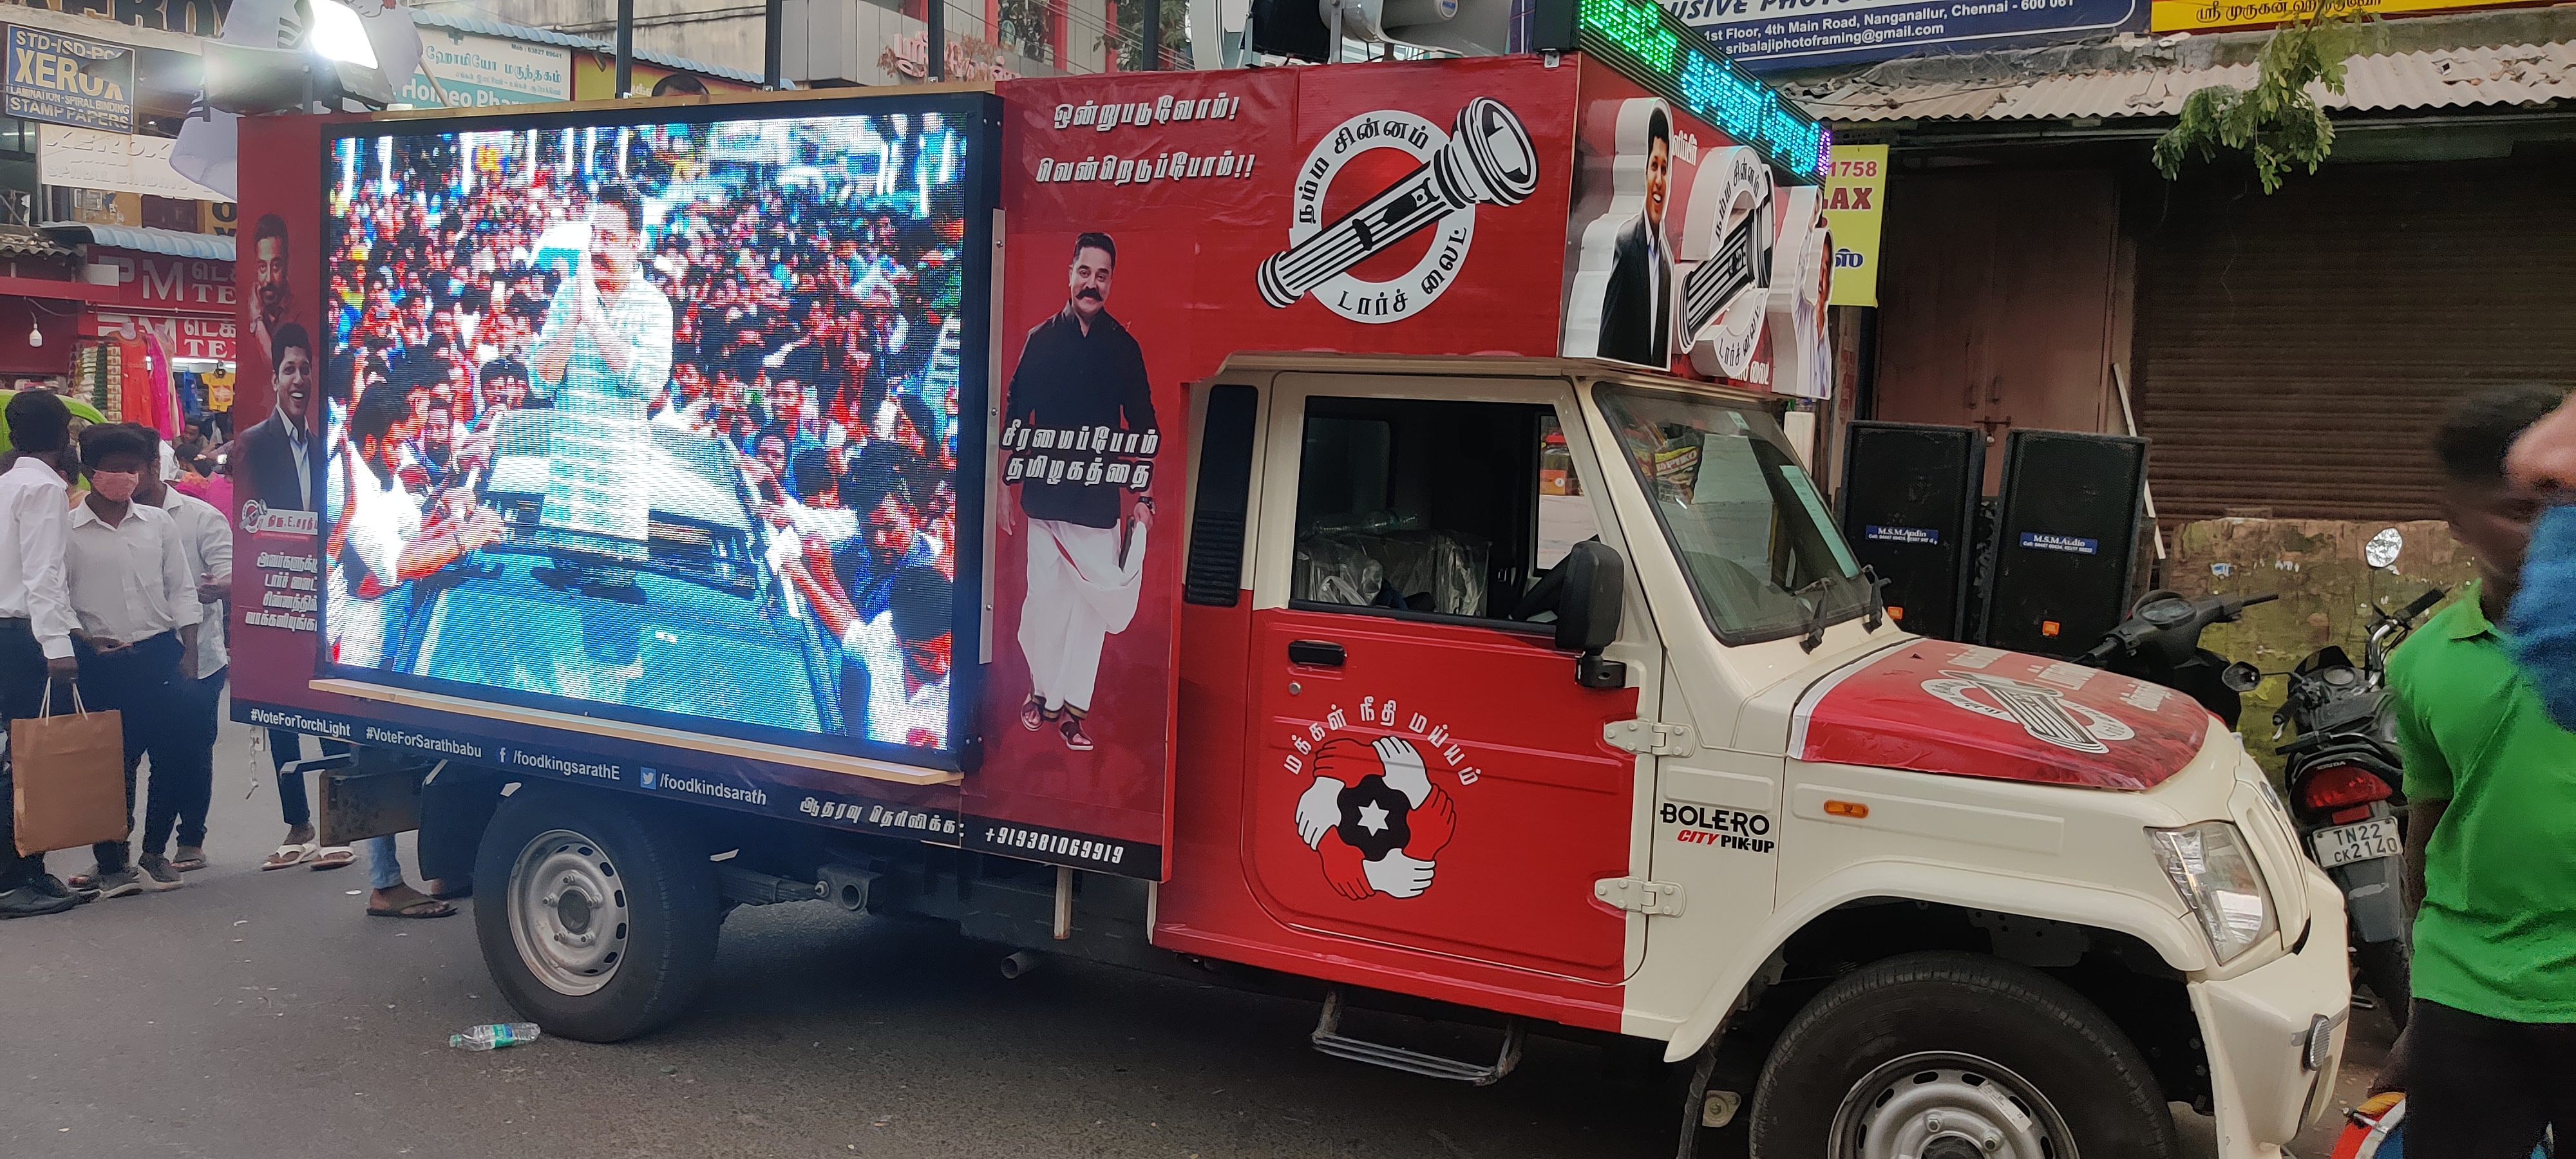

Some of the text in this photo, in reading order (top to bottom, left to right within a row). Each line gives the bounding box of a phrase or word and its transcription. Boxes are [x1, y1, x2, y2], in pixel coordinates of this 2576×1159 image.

[1704, 30, 1723, 41] 1st
[1726, 27, 1761, 40] Floor,
[1764, 24, 1785, 35] 4th
[1788, 20, 1819, 33] Main
[1823, 15, 1860, 30] Road,
[1864, 7, 1947, 26] Nanganallur,
[1951, 0, 2008, 17] Chennai
[1725, 24, 1944, 55] sribalajiphotoframing@gmail.com
[1054, 91, 1240, 132] ஒன்றுபடுவோம்!
[1334, 117, 1430, 155] சின்னம்
[1337, 288, 1409, 316] டார்ச்
[1001, 419, 1159, 455] சீரமைப்போம்
[1005, 455, 1150, 489] தமிழகத்தை
[250, 708, 351, 738] #VoteForTorchLight
[365, 726, 482, 759] #VoteForSarathbabu
[1283, 695, 1482, 786] மக்கள் நீதி மய்யம்
[1660, 802, 1770, 837] BOLERO
[1677, 829, 1775, 853] CITY PIK-UP
